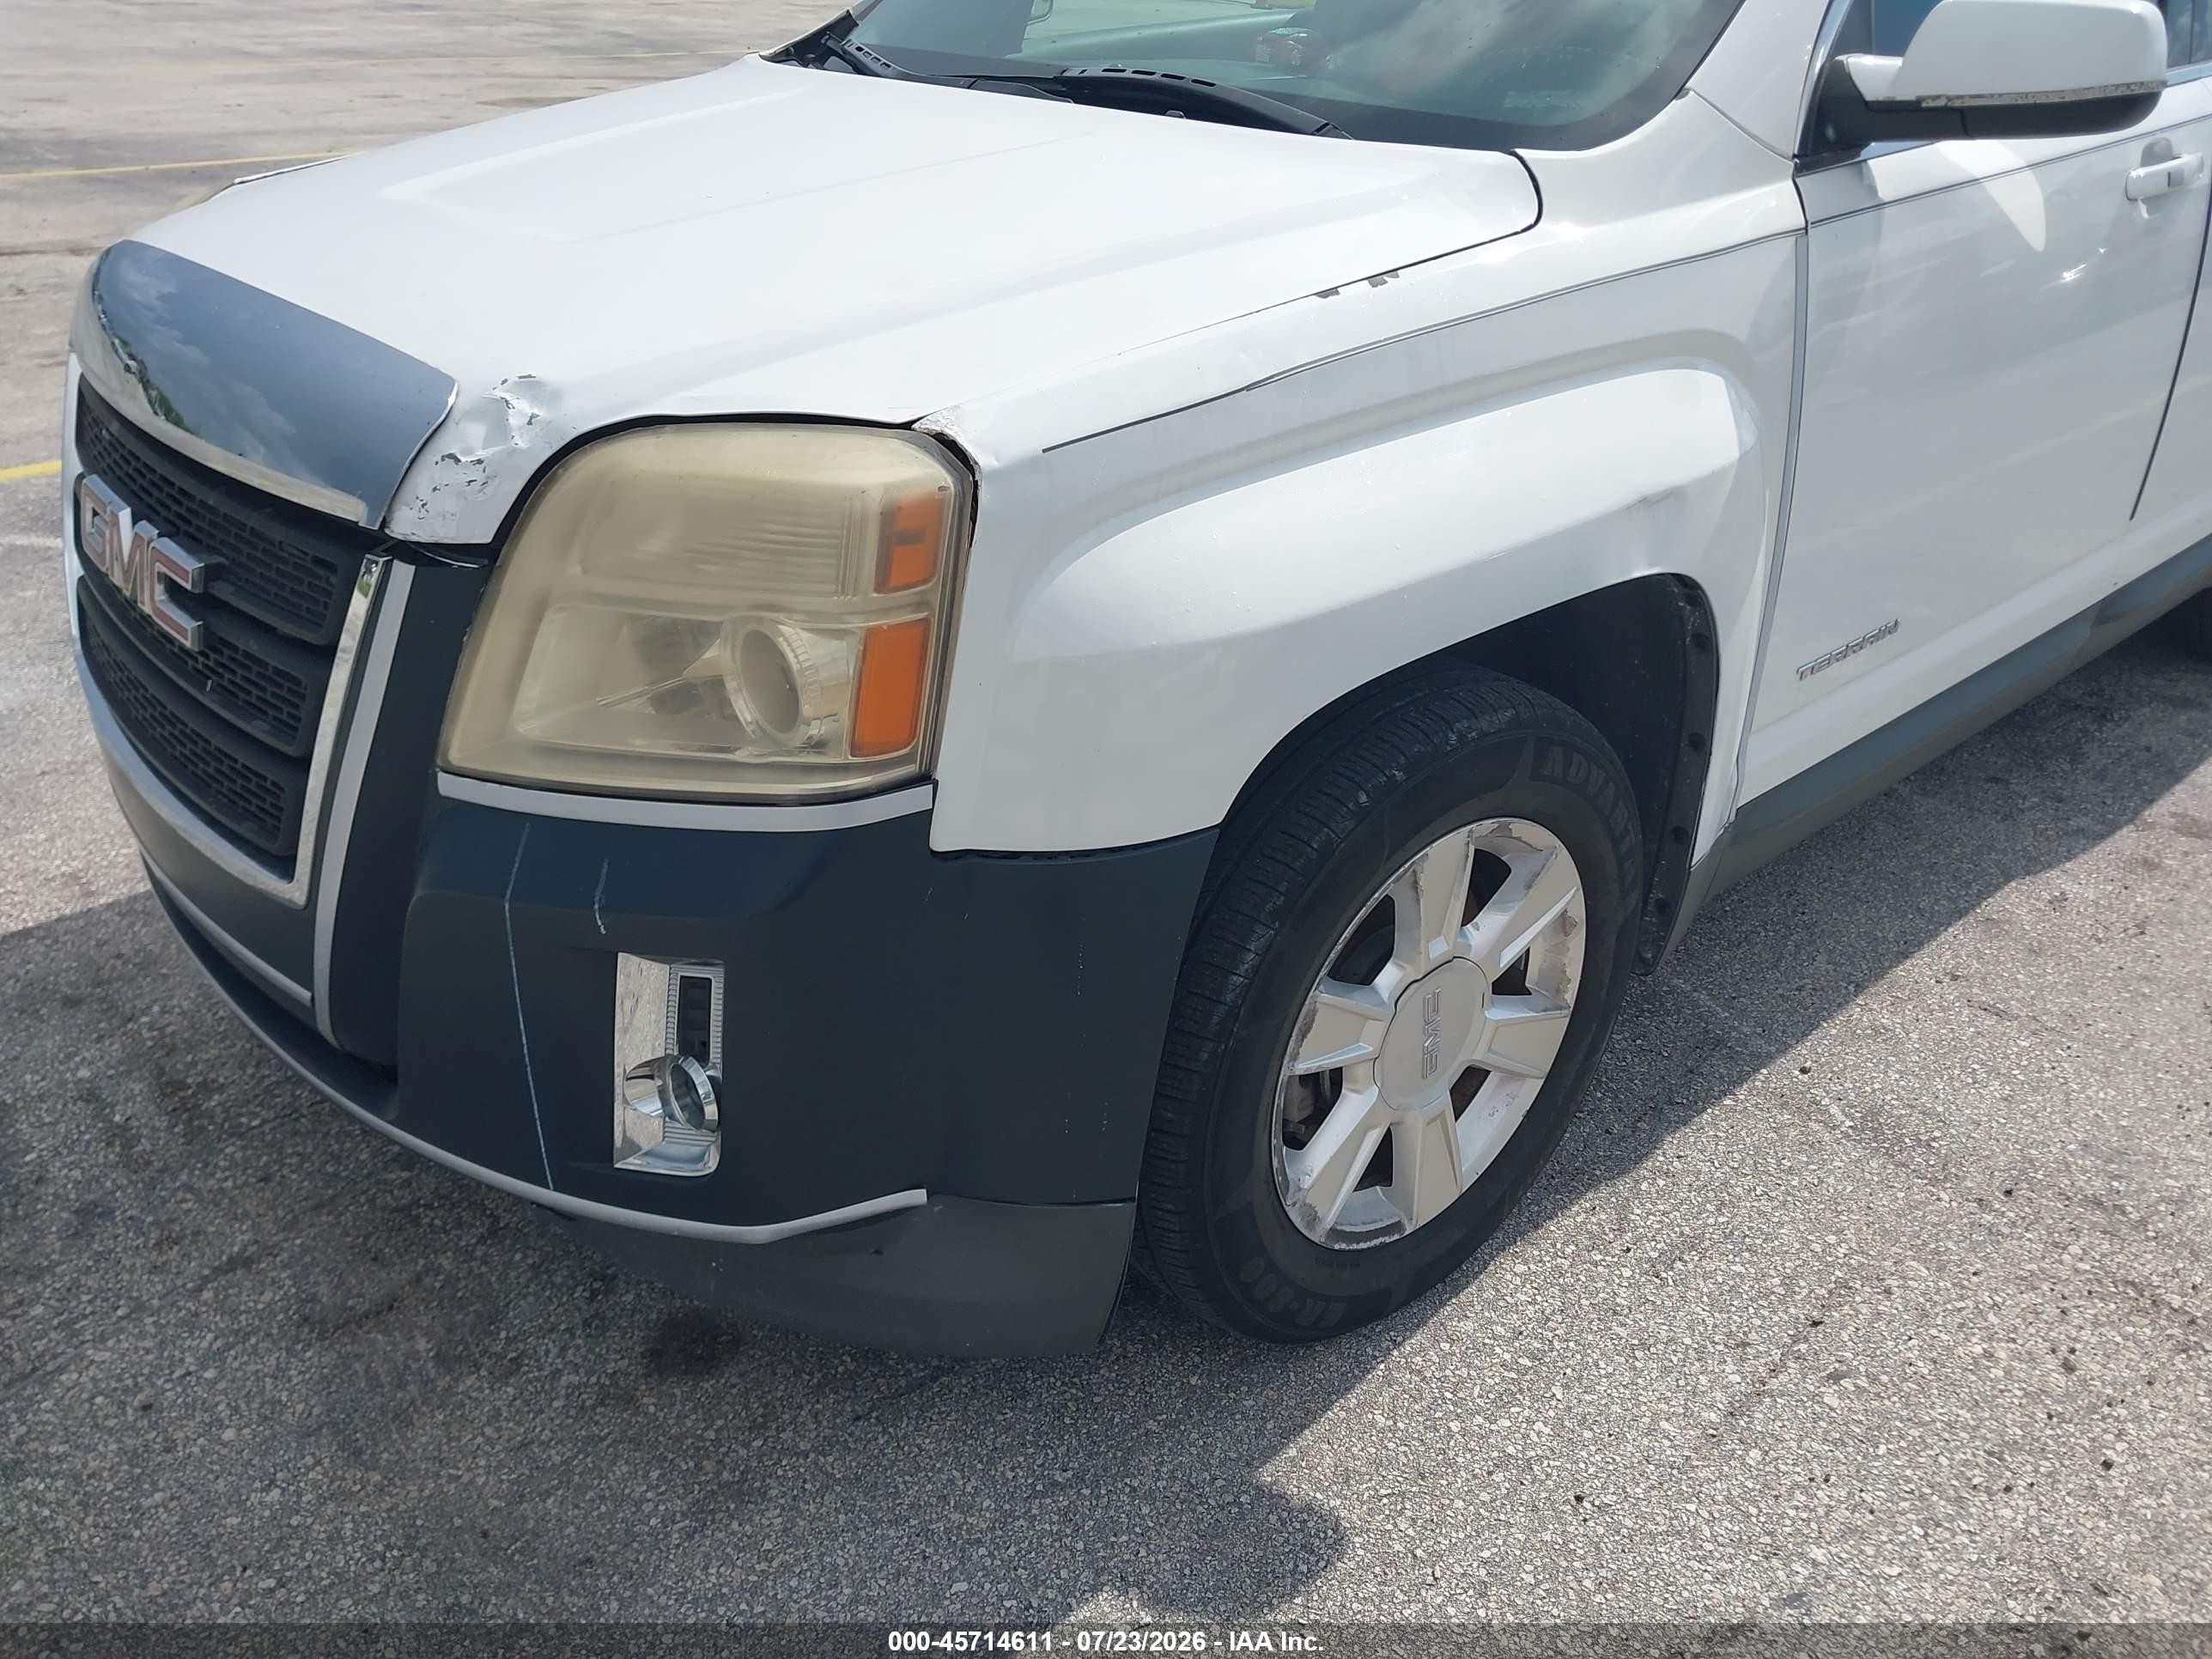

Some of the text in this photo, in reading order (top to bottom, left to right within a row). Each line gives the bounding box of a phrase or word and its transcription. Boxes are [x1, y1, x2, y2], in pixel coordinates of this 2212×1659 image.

[81, 474, 205, 652] GMC
[1796, 618, 1901, 681] TERRAIN
[1422, 988, 1442, 1079] GMC
